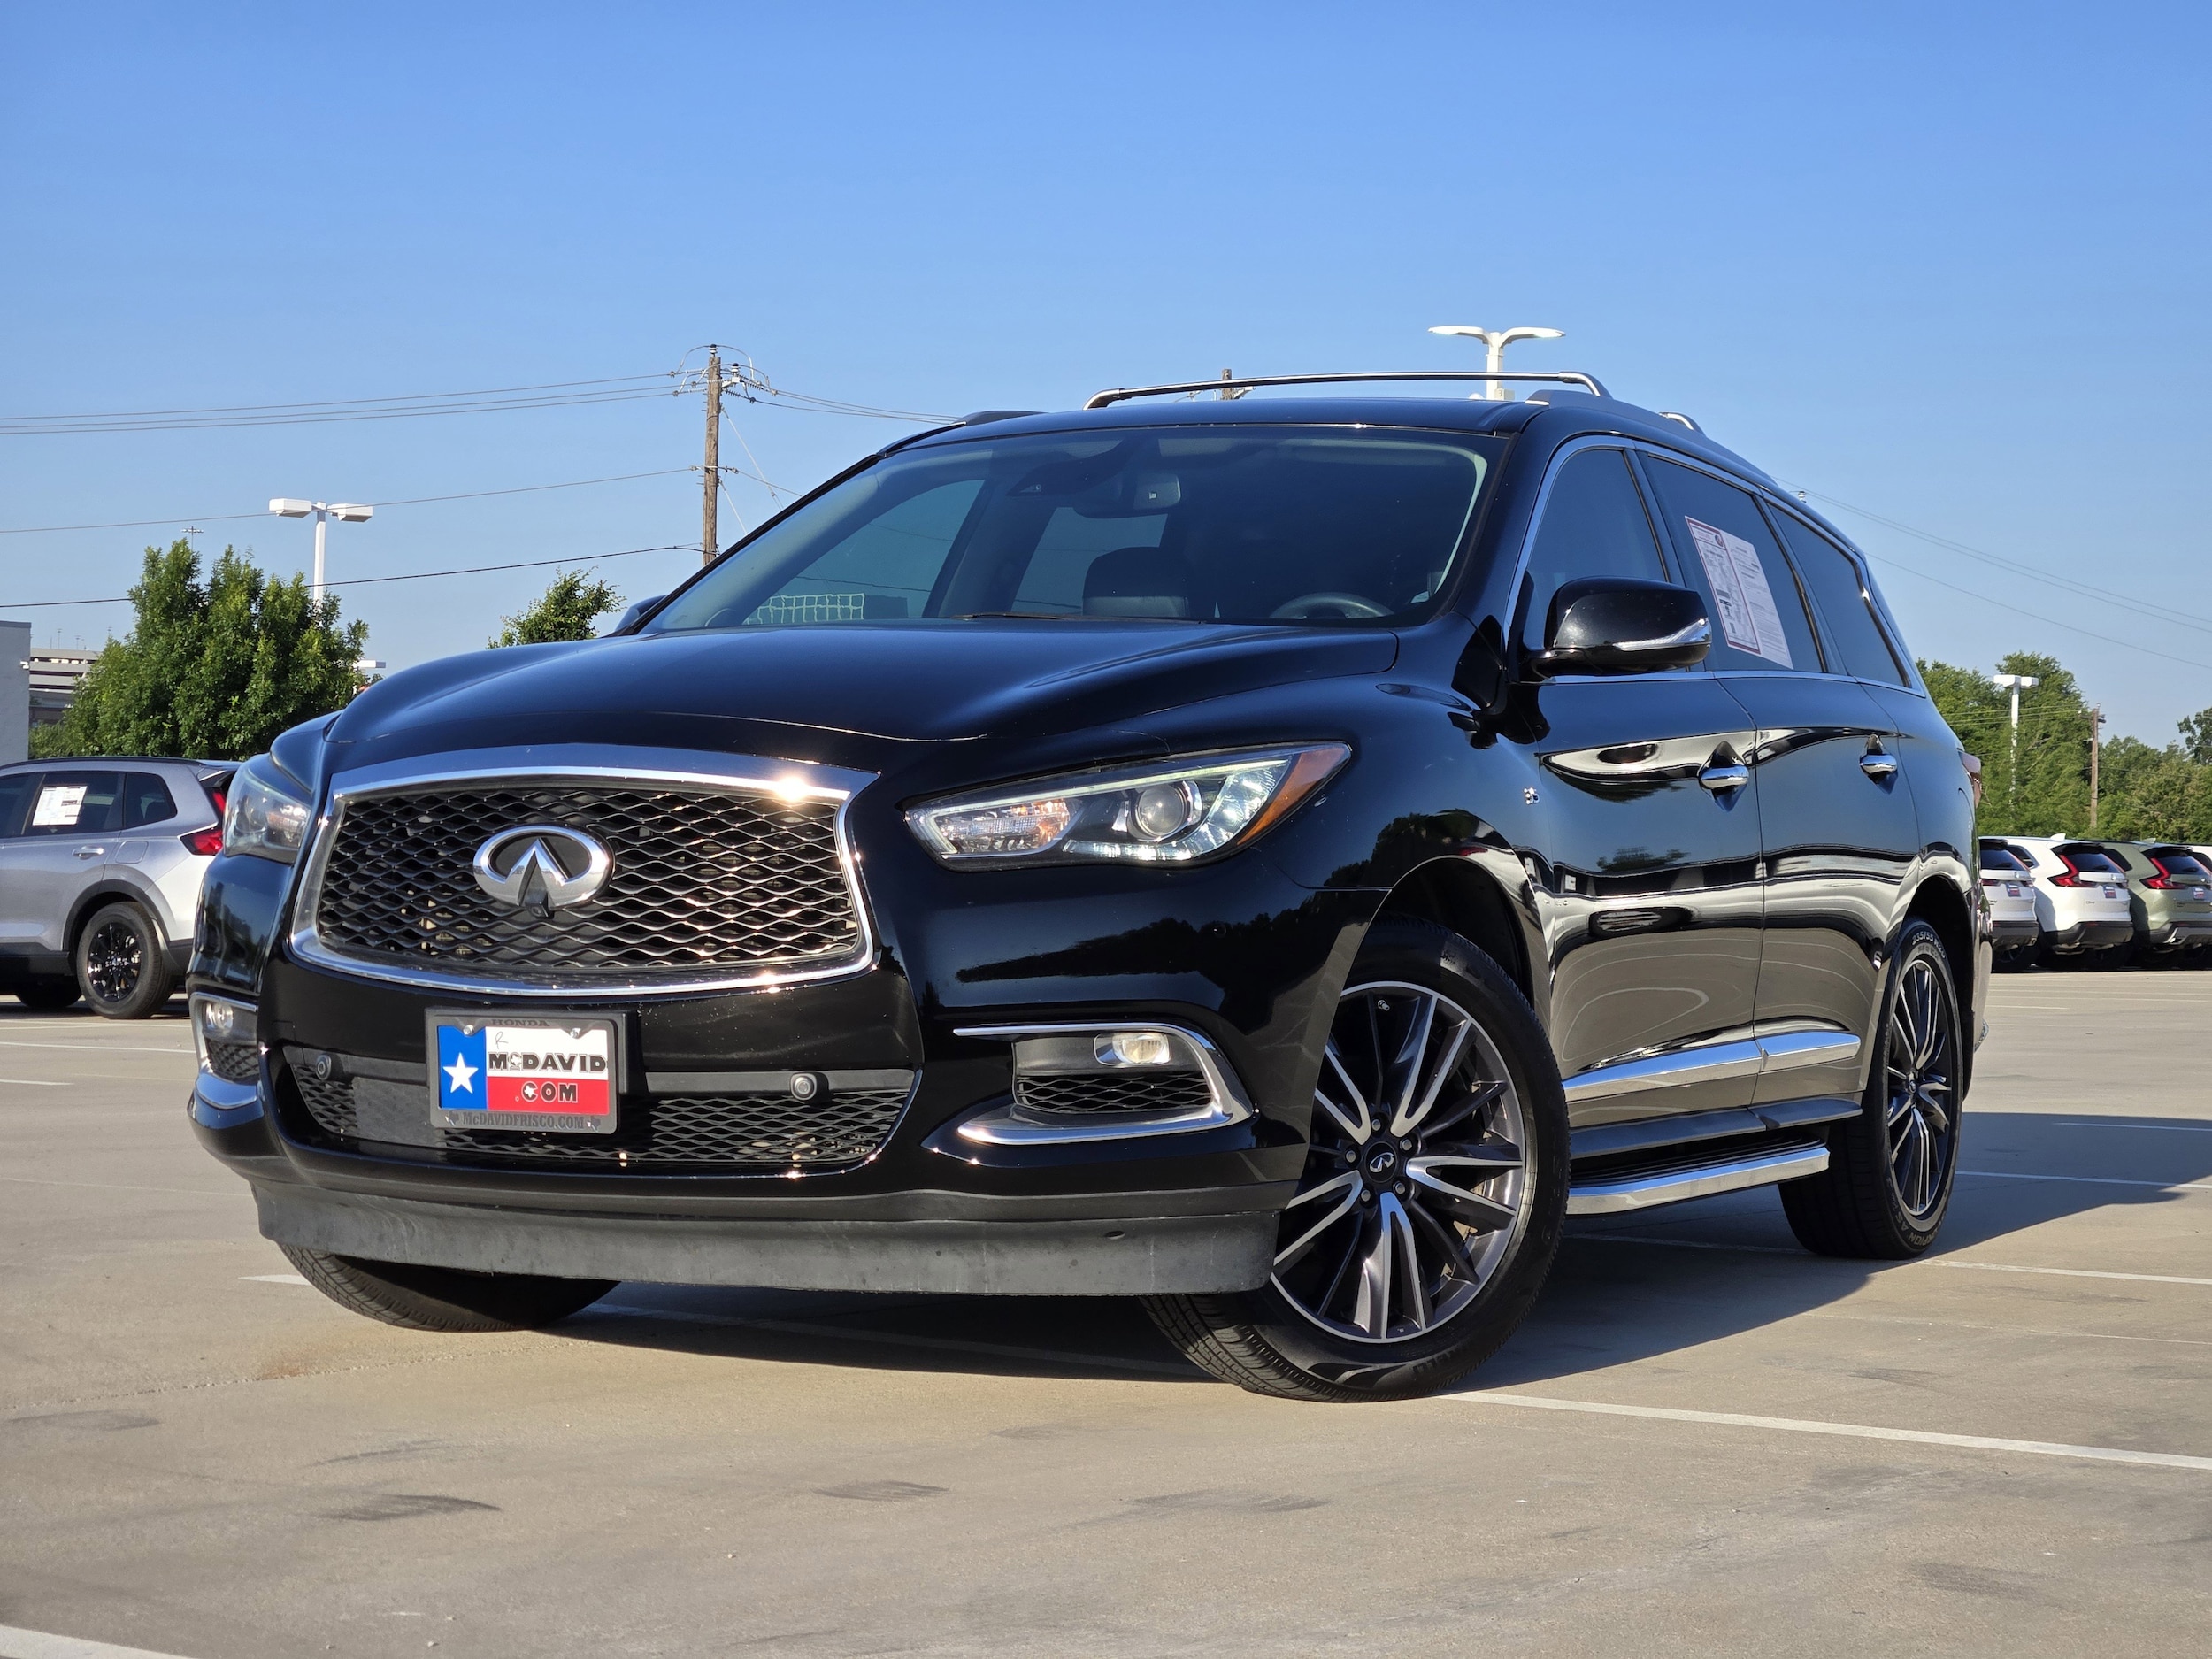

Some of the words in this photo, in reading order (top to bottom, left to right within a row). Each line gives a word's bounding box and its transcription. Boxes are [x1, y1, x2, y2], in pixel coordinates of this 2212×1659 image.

[491, 1018, 550, 1027] HONDA
[488, 1051, 608, 1073] McDAVID
[463, 1111, 585, 1130] McDAVIDFRISCO.COM
